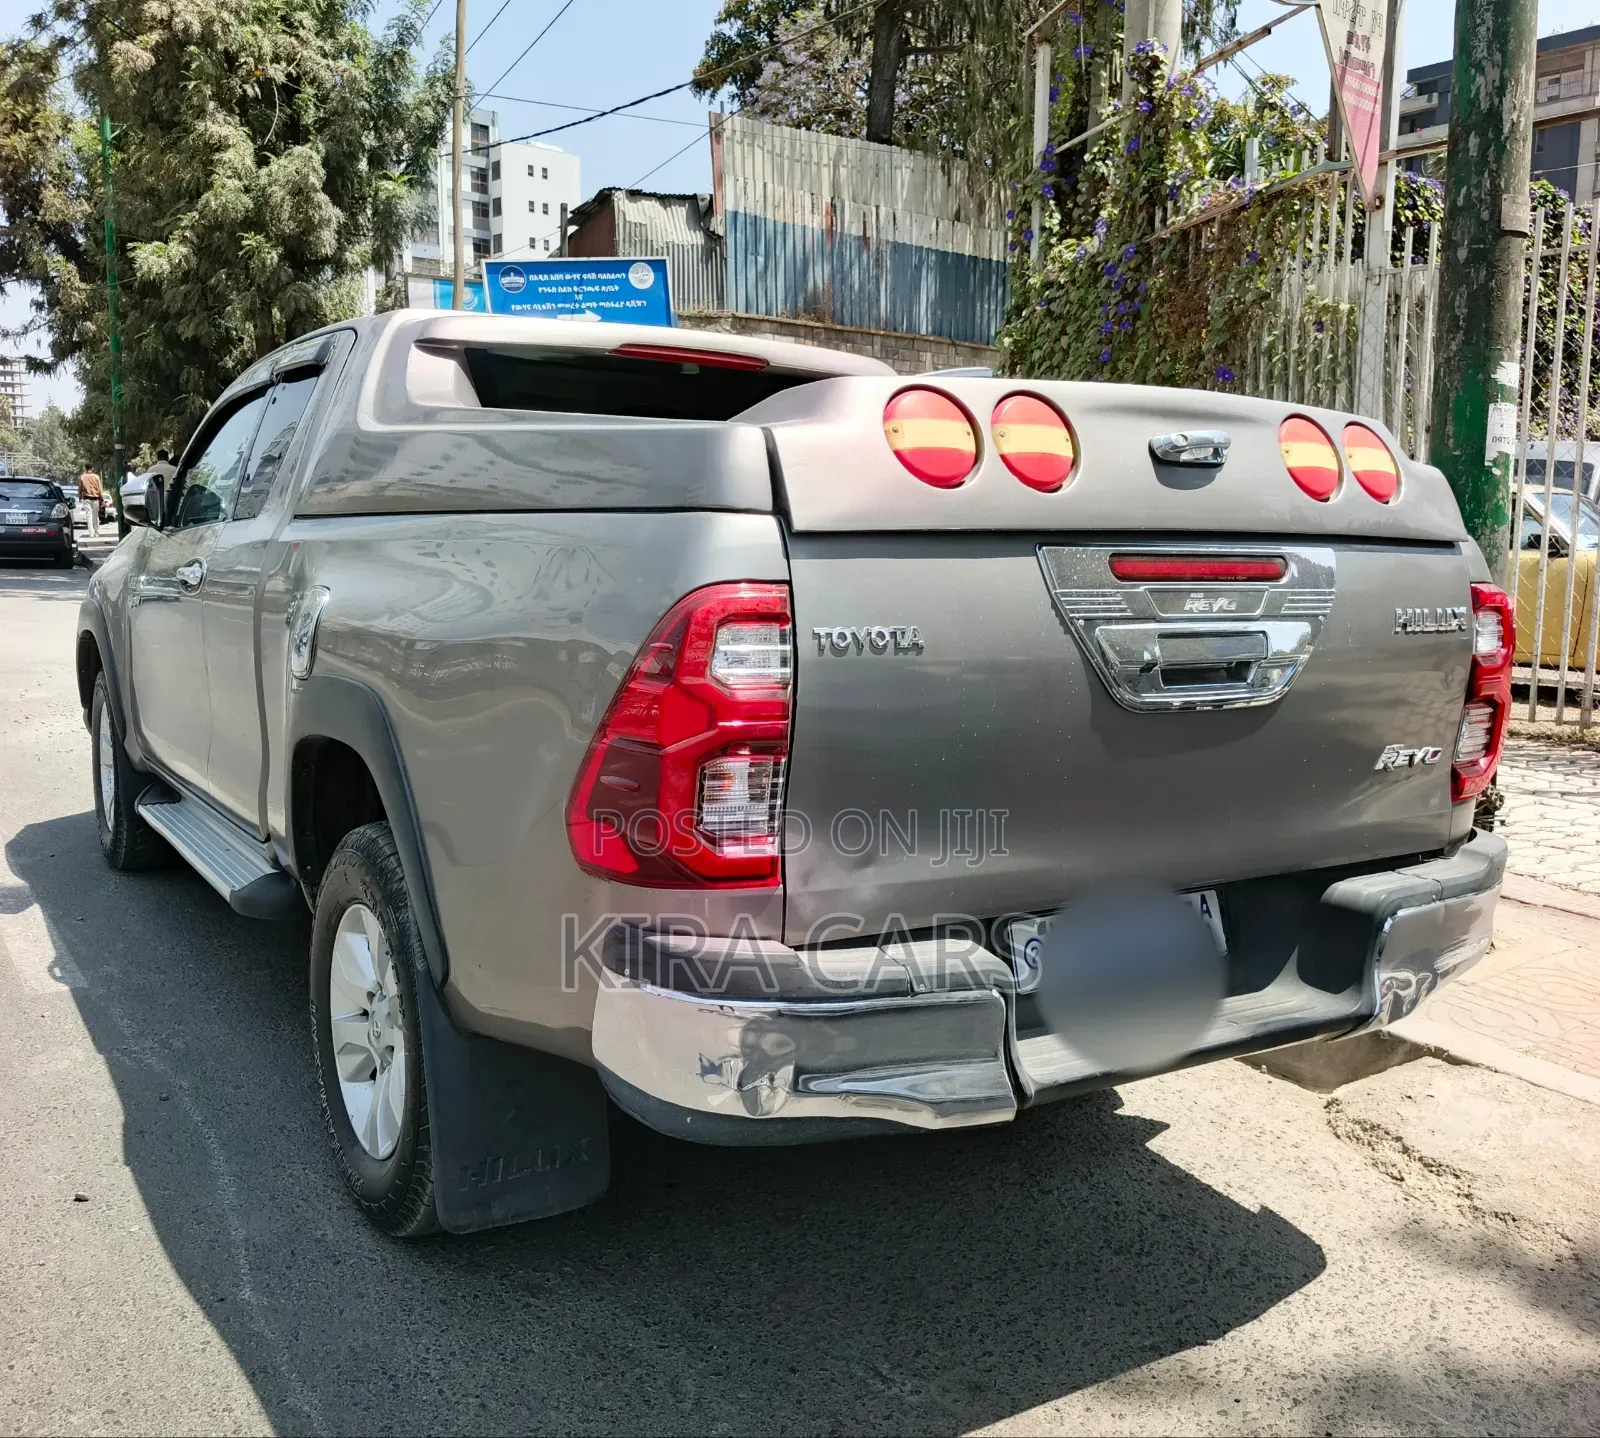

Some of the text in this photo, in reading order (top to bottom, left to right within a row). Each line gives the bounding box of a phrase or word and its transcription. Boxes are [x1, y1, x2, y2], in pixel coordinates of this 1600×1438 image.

[1394, 606, 1468, 635] HILUX
[812, 625, 925, 651] TOYOTA
[1375, 745, 1442, 772] REVO
[460, 1138, 592, 1192] HILUX
